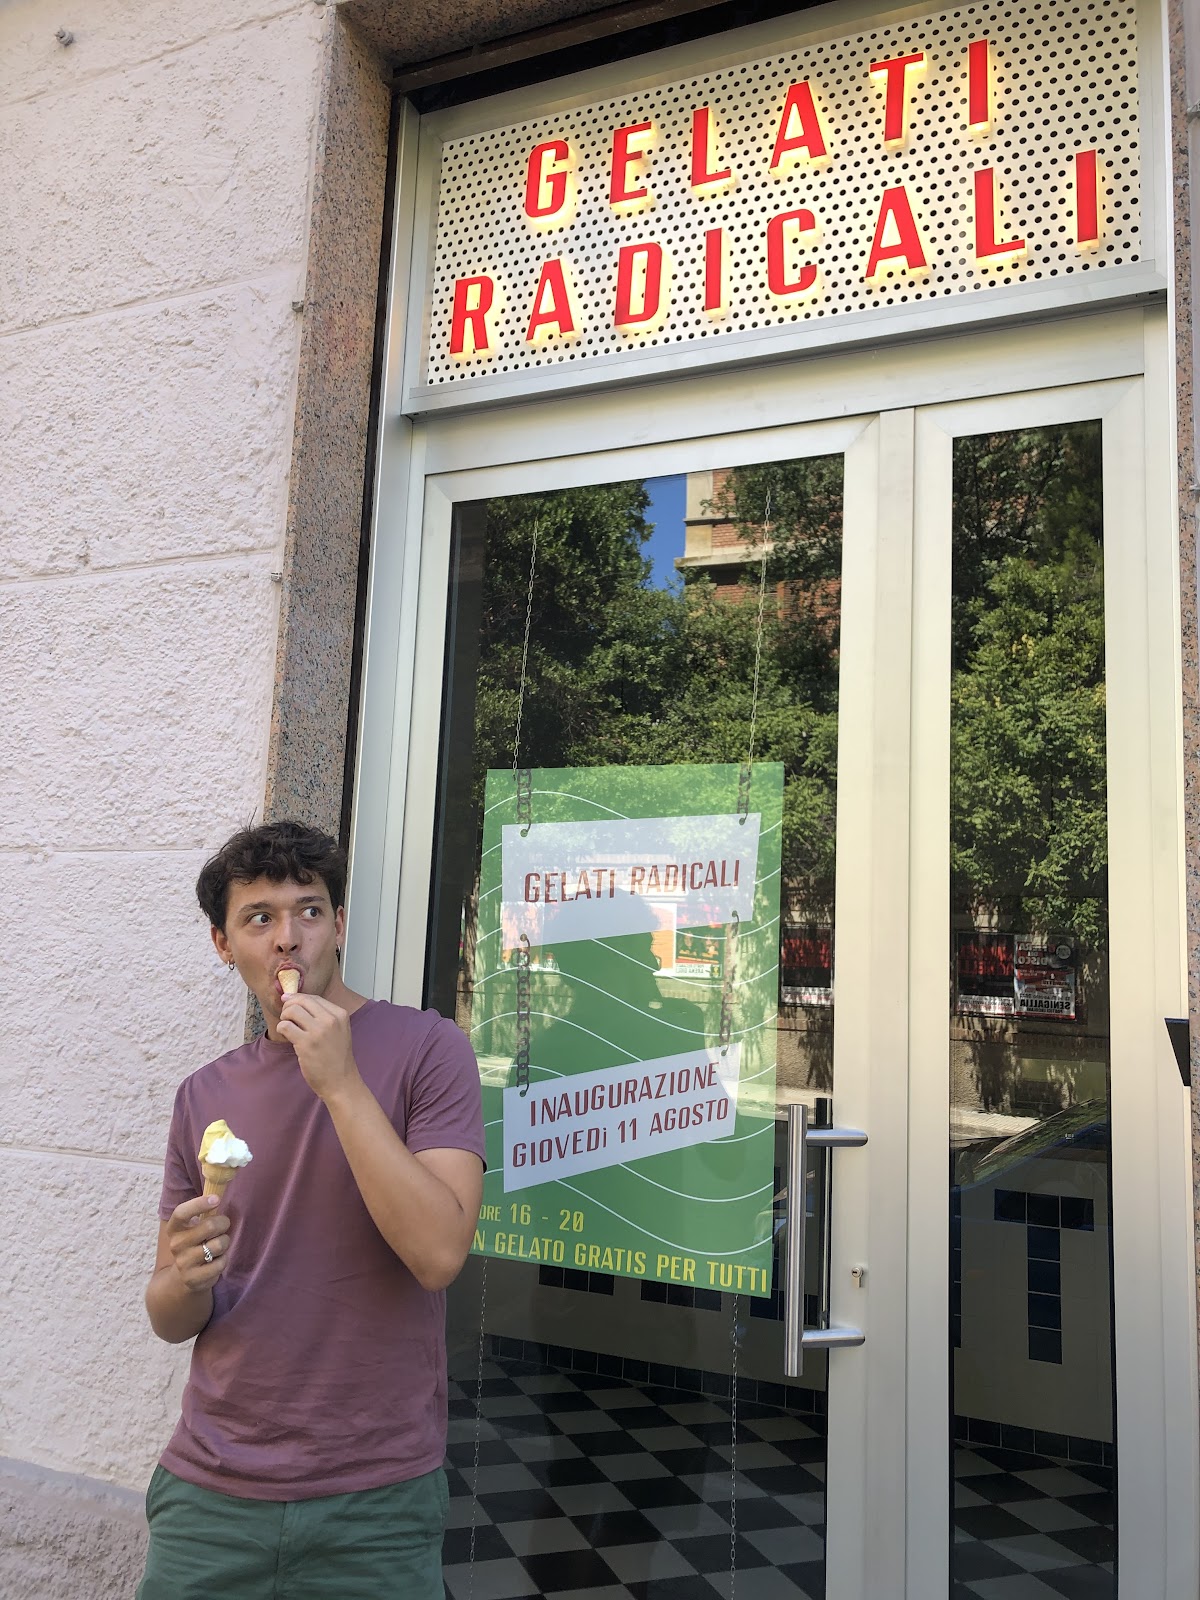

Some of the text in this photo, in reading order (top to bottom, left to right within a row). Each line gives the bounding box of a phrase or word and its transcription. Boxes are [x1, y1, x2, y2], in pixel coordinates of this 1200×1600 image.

[522, 39, 990, 219] GELATI
[449, 149, 1098, 355] RADICALI
[524, 859, 741, 904] GELATI RADICALI
[530, 1061, 720, 1127] INAUGURAZIONE
[617, 1118, 638, 1144] 11
[649, 1097, 729, 1137] AGOSTO
[478, 1204, 502, 1222] ORE
[510, 1203, 532, 1226] 16
[559, 1209, 585, 1233] 20
[494, 1232, 565, 1263] GELATO
[574, 1243, 646, 1275] GRATIS
[656, 1254, 696, 1282] PER
[707, 1261, 768, 1293] TUTTI
